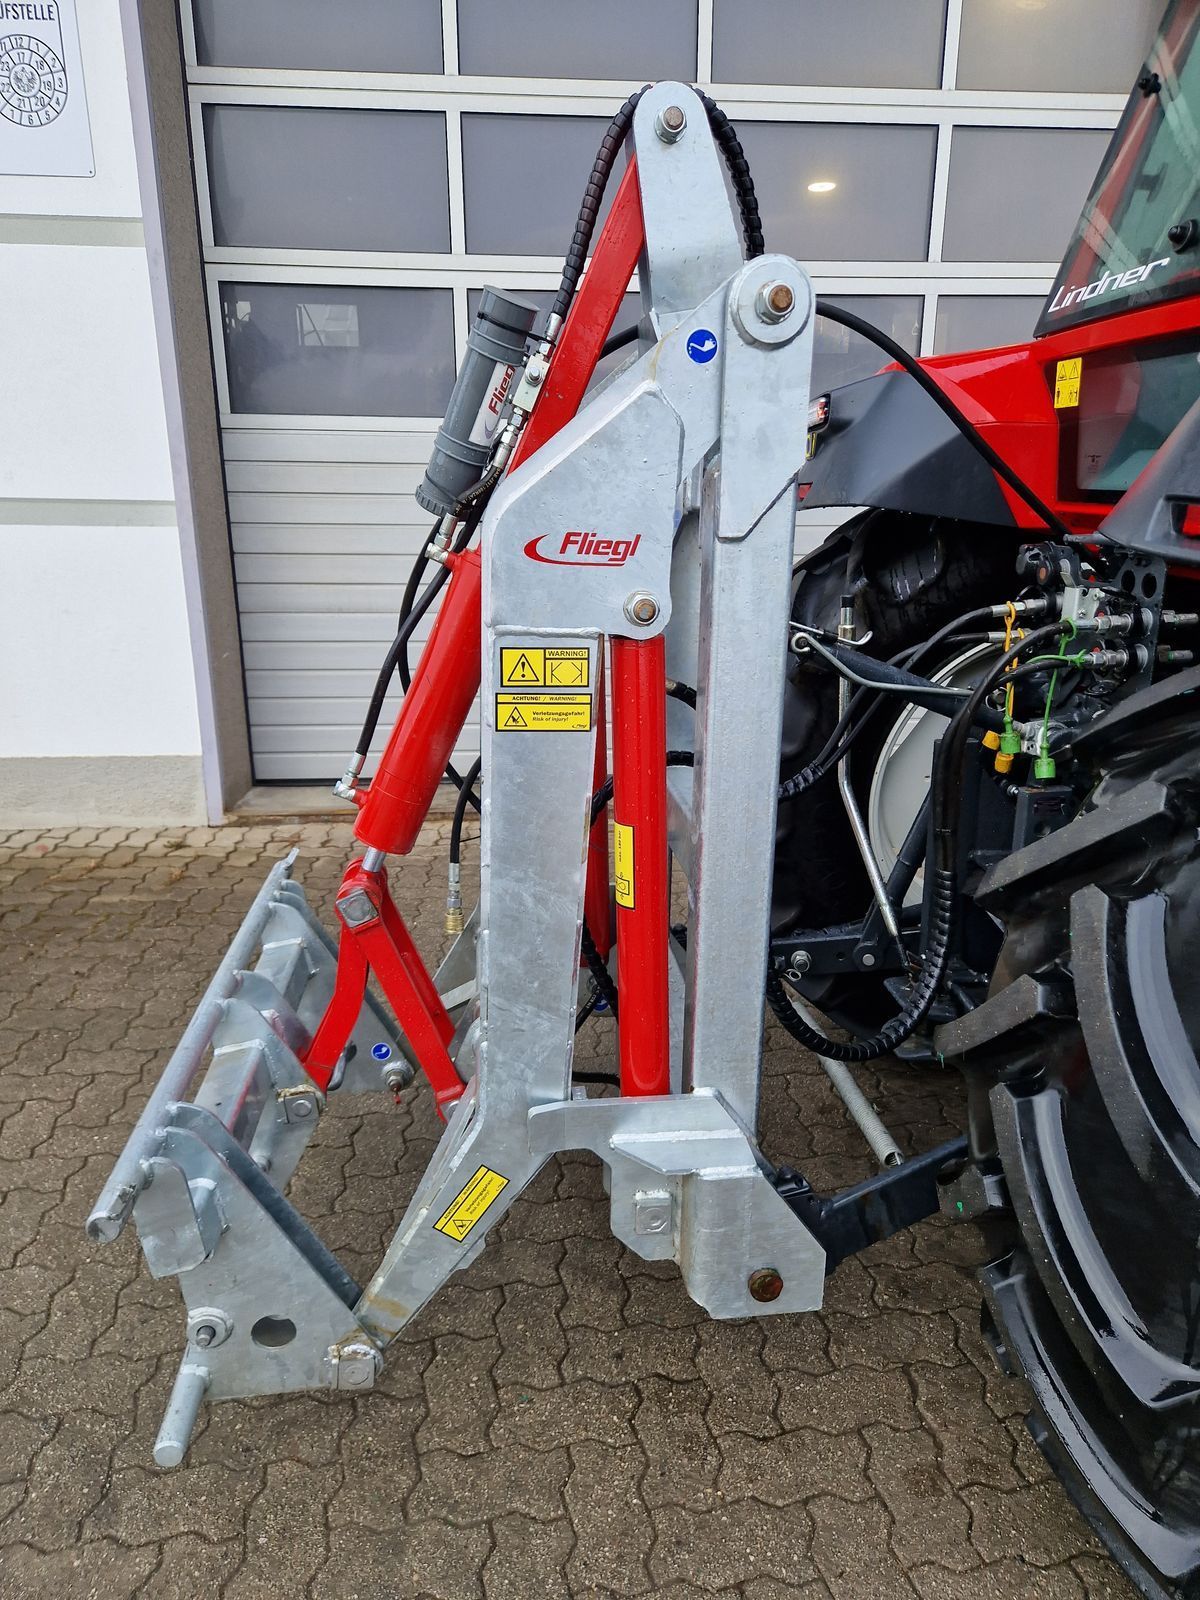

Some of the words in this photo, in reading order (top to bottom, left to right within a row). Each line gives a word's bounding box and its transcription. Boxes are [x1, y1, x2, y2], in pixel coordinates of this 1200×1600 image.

[15, 36, 24, 48] 12
[35, 43, 40, 53] 1
[17, 52, 26, 63] 17
[51, 58, 57, 68] 2
[0, 61, 10, 72] 23
[35, 60, 45, 71] 18
[1, 82, 11, 93] 22
[42, 81, 52, 92] 19
[58, 77, 64, 88] 3
[17, 97, 27, 109] 21
[34, 96, 45, 108] 20
[55, 97, 61, 107] 4
[28, 114, 34, 125] 6
[45, 110, 51, 121] 5
[1047, 257, 1171, 313] Lindner
[488, 364, 516, 416] Flieg
[558, 531, 642, 562] Fliegl
